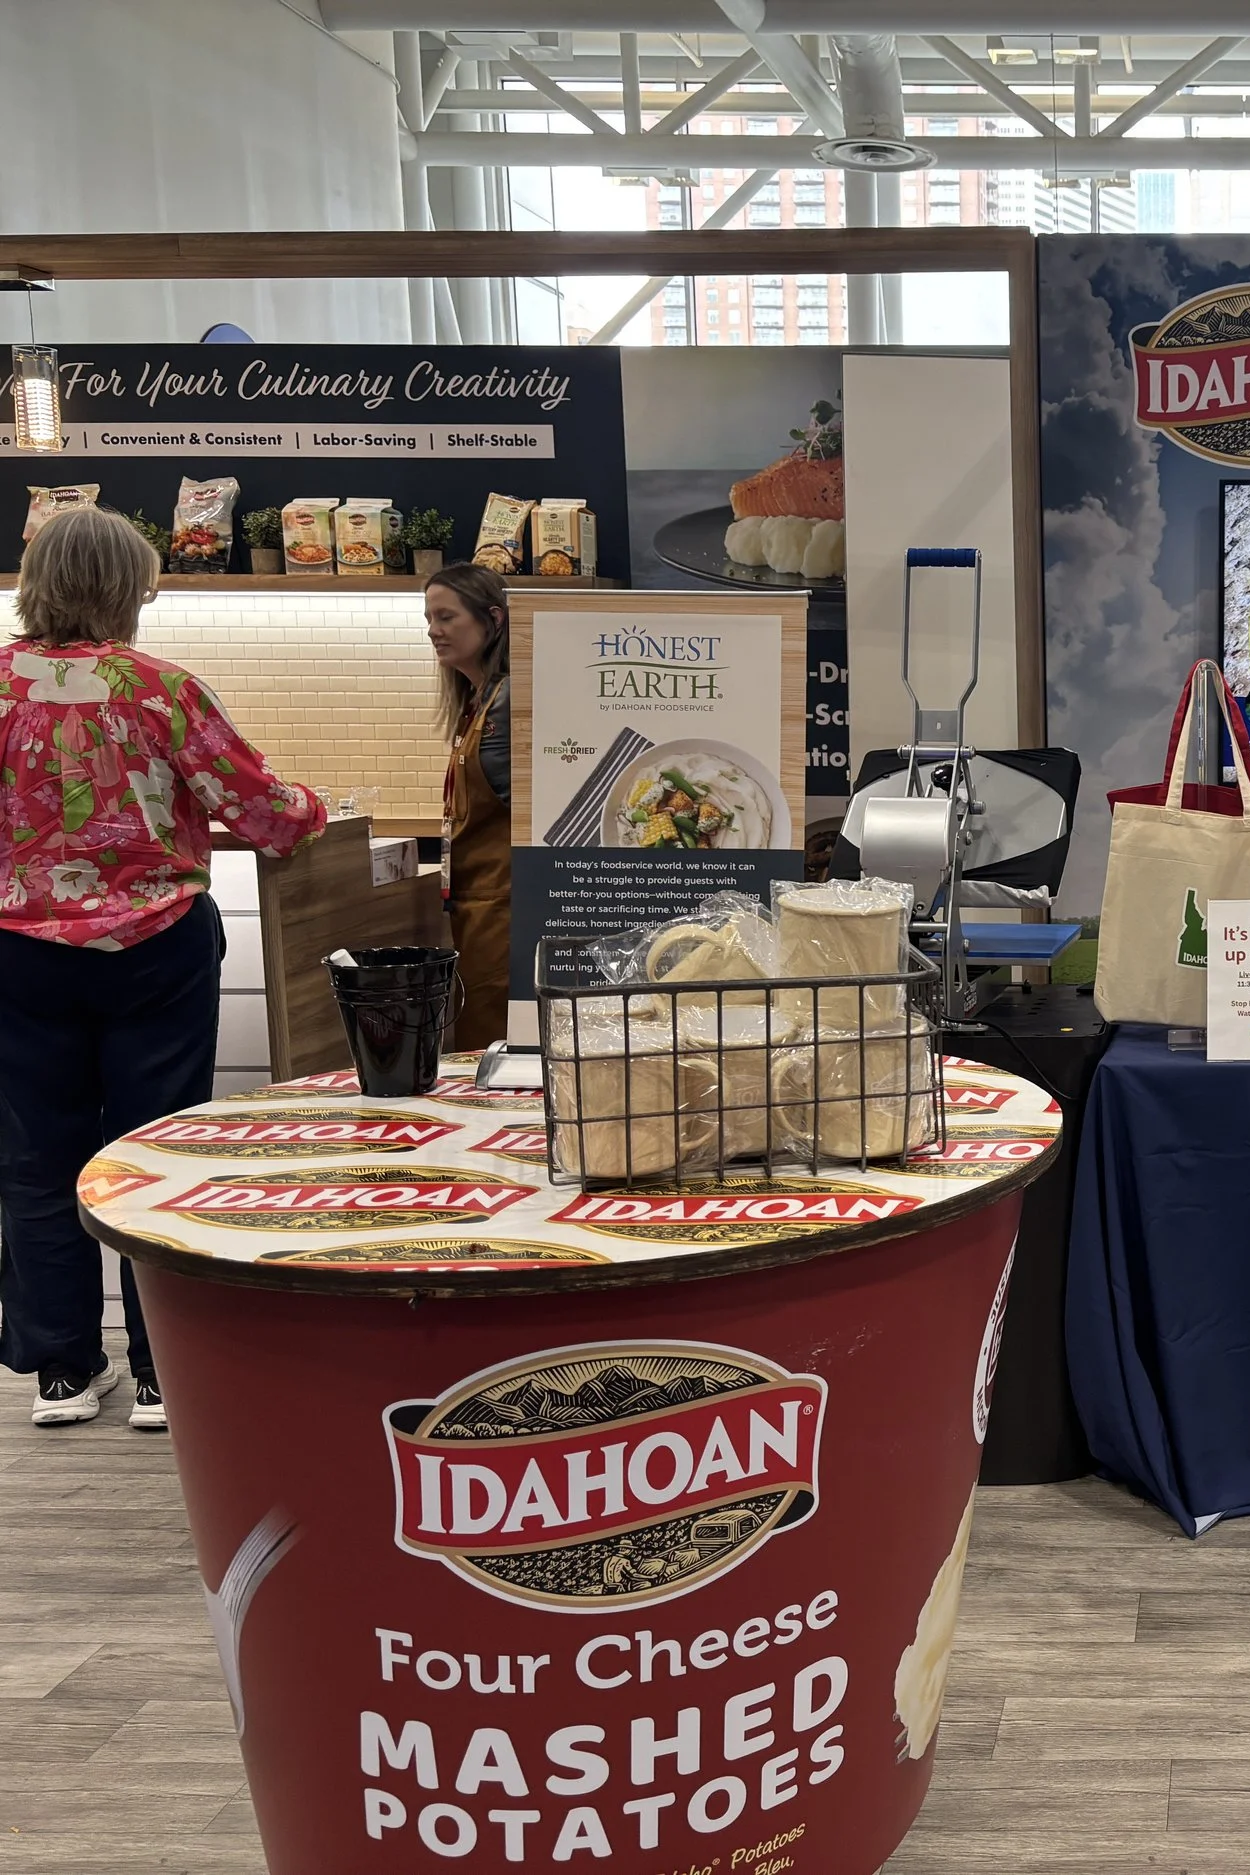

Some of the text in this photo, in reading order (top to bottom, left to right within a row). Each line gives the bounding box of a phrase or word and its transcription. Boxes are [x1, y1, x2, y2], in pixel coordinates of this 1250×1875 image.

[59, 361, 126, 400] For
[136, 361, 227, 408] Your
[237, 359, 395, 410] Culinary
[404, 360, 572, 411] Creativity
[101, 432, 538, 450] Convenient & Consistent Labor-Saving Shelf-Stable
[591, 633, 721, 662] HONEST
[597, 670, 719, 699] EARTH
[600, 703, 714, 712] by IDAHOAN FOODSERVICE
[570, 747, 595, 755] DRIED
[554, 861, 564, 869] In
[566, 861, 599, 872] today's
[600, 861, 653, 870] foodservice
[655, 862, 684, 871] world,
[702, 862, 728, 870] know
[729, 862, 736, 871] it
[572, 875, 584, 884] be
[595, 875, 633, 887] struggle
[635, 876, 645, 885] to
[647, 876, 682, 887] provide
[684, 877, 714, 888] guests
[716, 876, 737, 885] with
[549, 889, 613, 899] better-for-you
[561, 905, 584, 913] taste
[598, 904, 646, 915] sacrificing
[648, 905, 671, 914] time.
[673, 906, 688, 914] We
[545, 919, 622, 929] delicious, honest
[1224, 926, 1248, 941] It's
[554, 948, 572, 957] and
[1225, 949, 1247, 965] up
[550, 963, 593, 973] nurtuing
[1231, 1000, 1247, 1008] Stop
[147, 1123, 445, 1142] IDAHOAN
[191, 1185, 517, 1210] IDAHOAN
[563, 1197, 911, 1222] IDAHOAN
[415, 1400, 802, 1535] IDAHOAN
[375, 1589, 839, 1694] Four Cheese
[360, 1655, 849, 1797] MASHED
[363, 1724, 845, 1863] POTATOES
[731, 1821, 806, 1869] Potatoes
